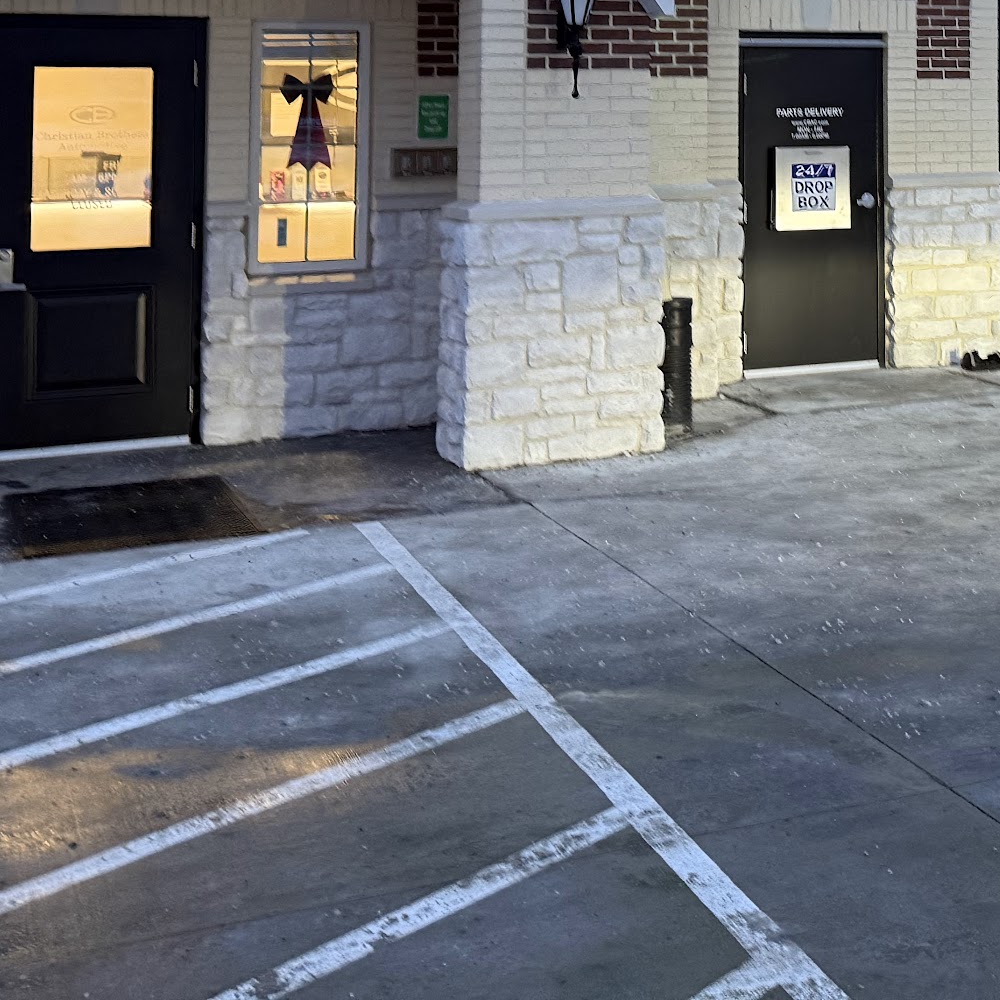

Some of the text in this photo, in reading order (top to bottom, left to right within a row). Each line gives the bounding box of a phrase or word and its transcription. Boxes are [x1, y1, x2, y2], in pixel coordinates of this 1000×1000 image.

[776, 107, 844, 118] PARTS DELIVERY
[795, 164, 834, 178] 24/7
[795, 180, 833, 194] DROP
[798, 195, 829, 209] BOX
